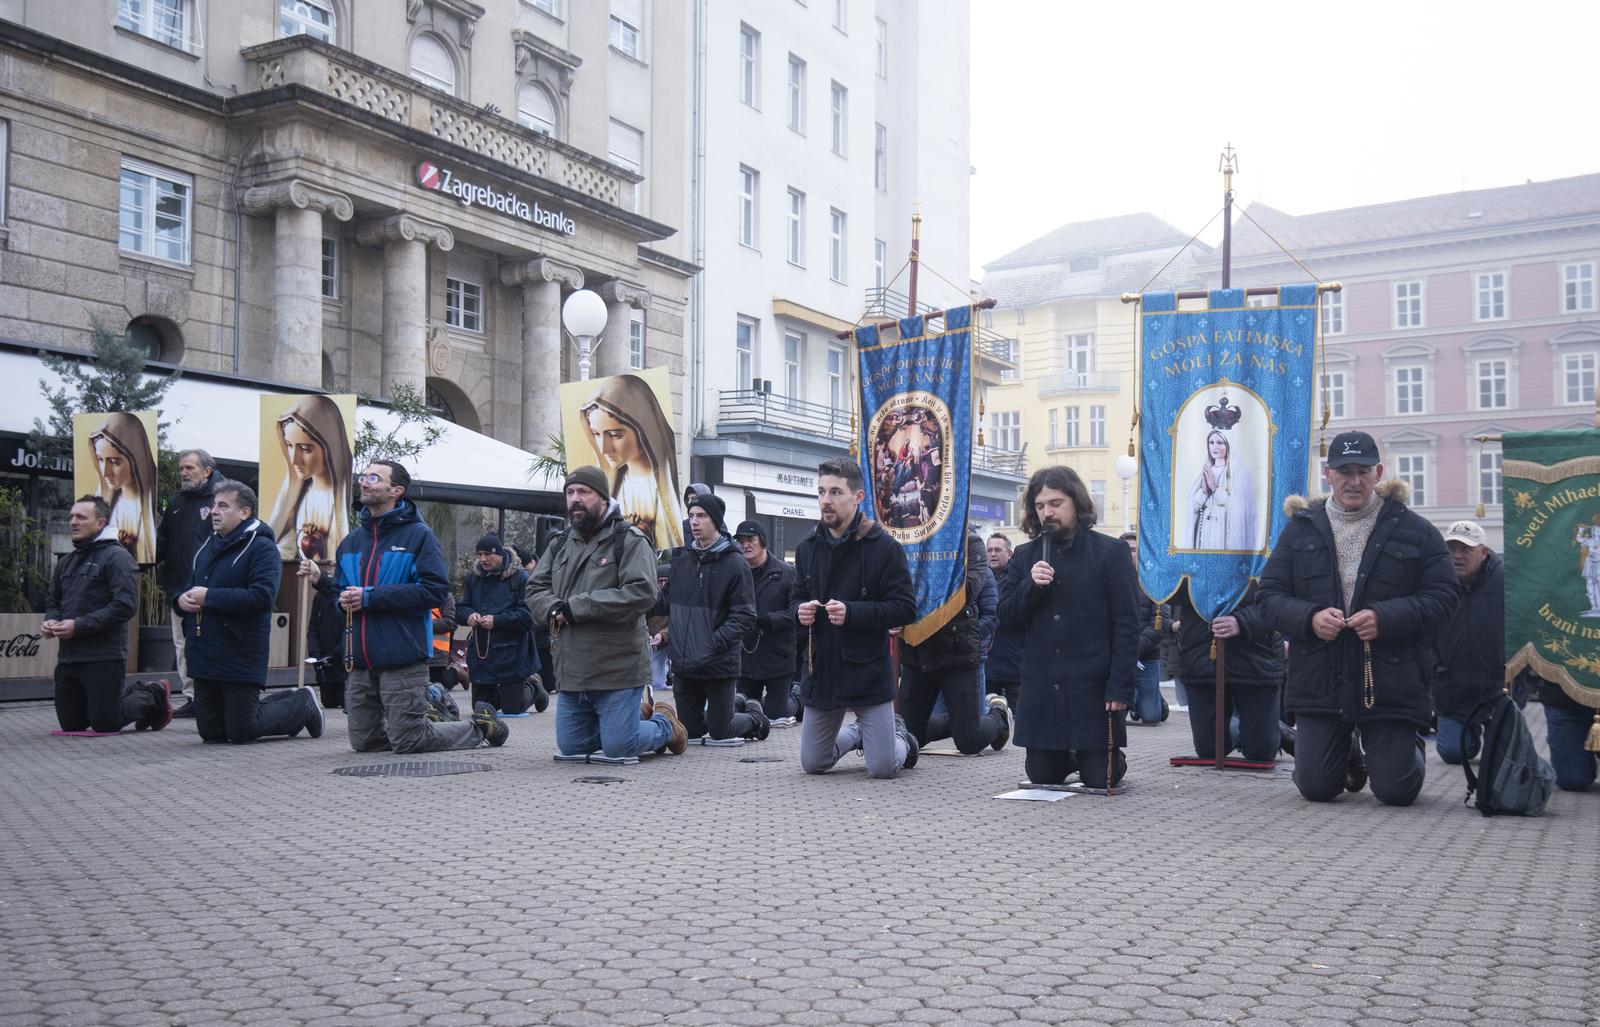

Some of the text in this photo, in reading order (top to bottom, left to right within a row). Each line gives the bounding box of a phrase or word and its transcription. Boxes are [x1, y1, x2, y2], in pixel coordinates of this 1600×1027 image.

[441, 169, 575, 236] Zagrebačka banka
[1151, 329, 1304, 360] GOSPA FATIMSKA
[1164, 351, 1287, 378] MOLI ZA NAS
[876, 375, 904, 394] MOLI
[782, 507, 805, 517] CHANEL
[1516, 509, 1548, 548] Sveti
[1538, 602, 1578, 636] brani
